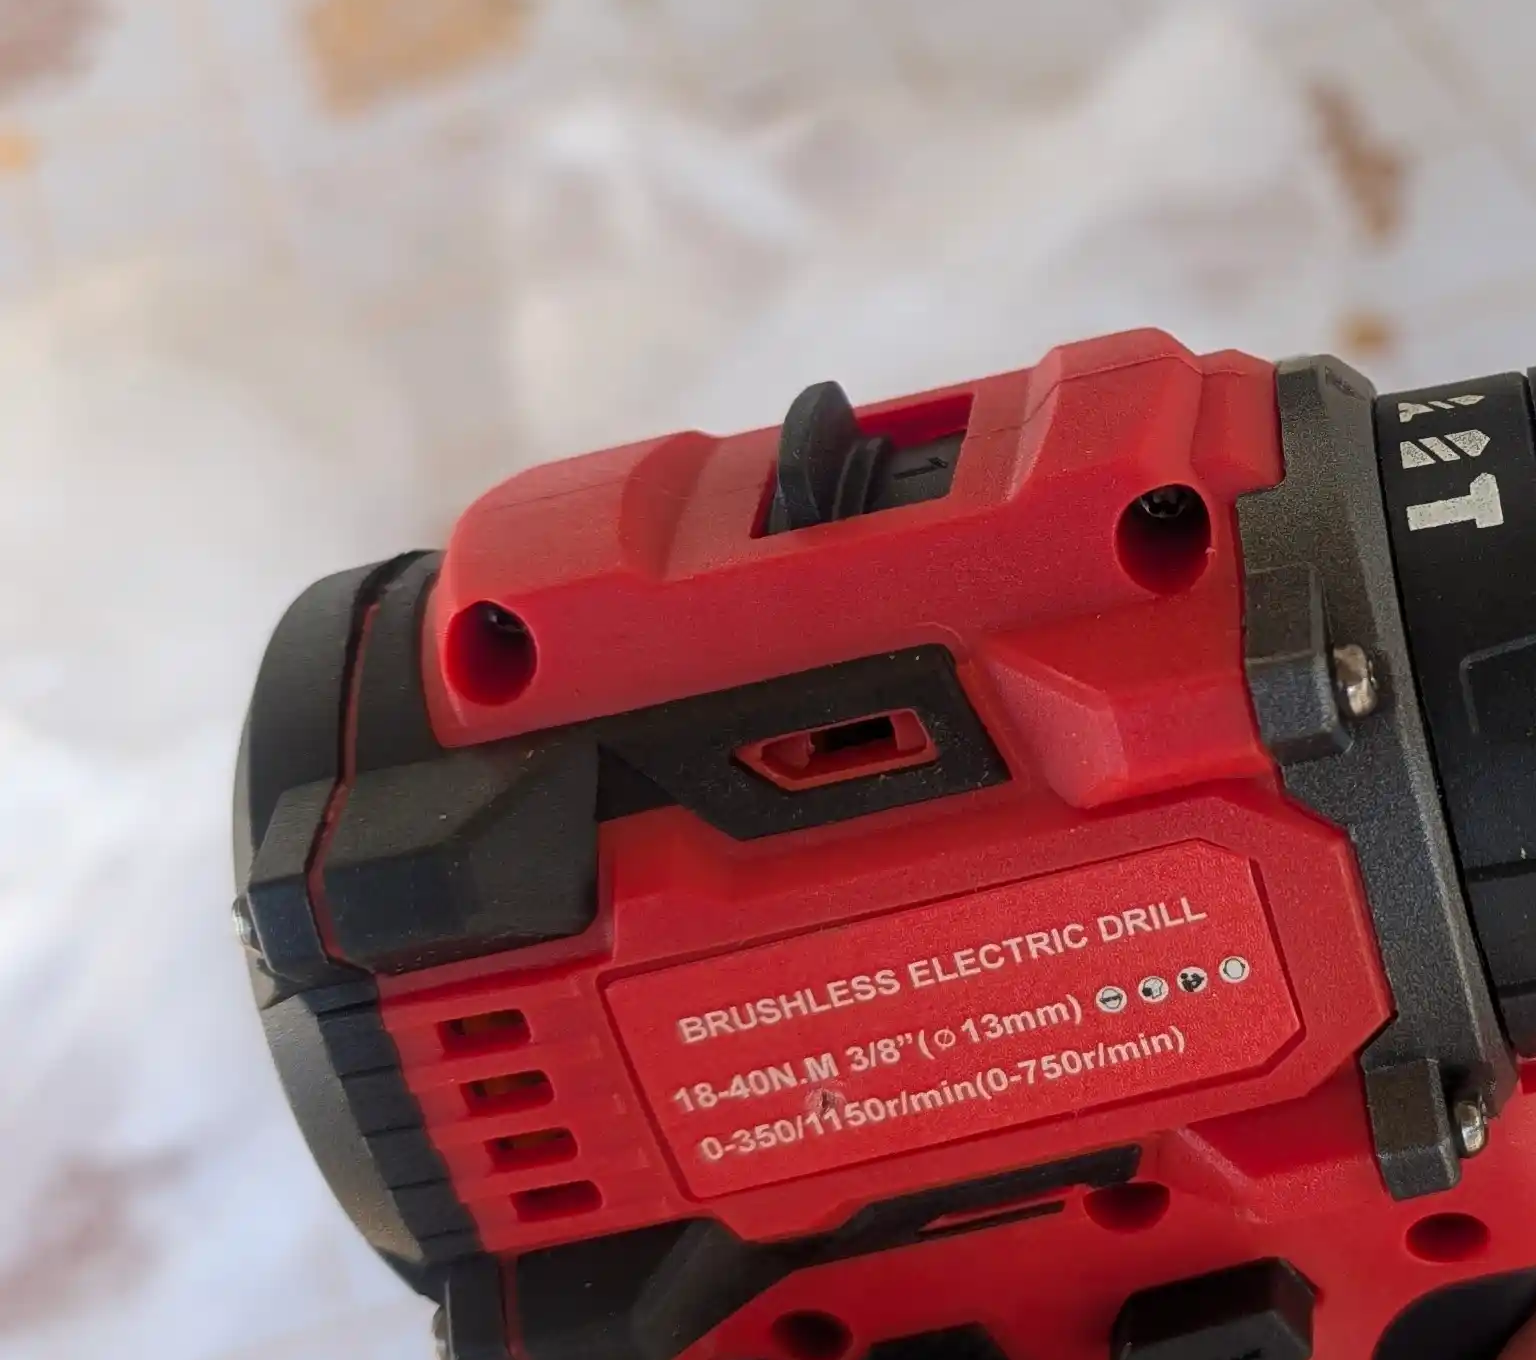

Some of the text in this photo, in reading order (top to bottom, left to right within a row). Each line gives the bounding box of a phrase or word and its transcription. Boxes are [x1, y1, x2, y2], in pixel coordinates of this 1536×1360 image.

[678, 896, 1208, 1044] BRUSHLESS ELECTRIC DRILL
[673, 1052, 840, 1113] 18-40N.M
